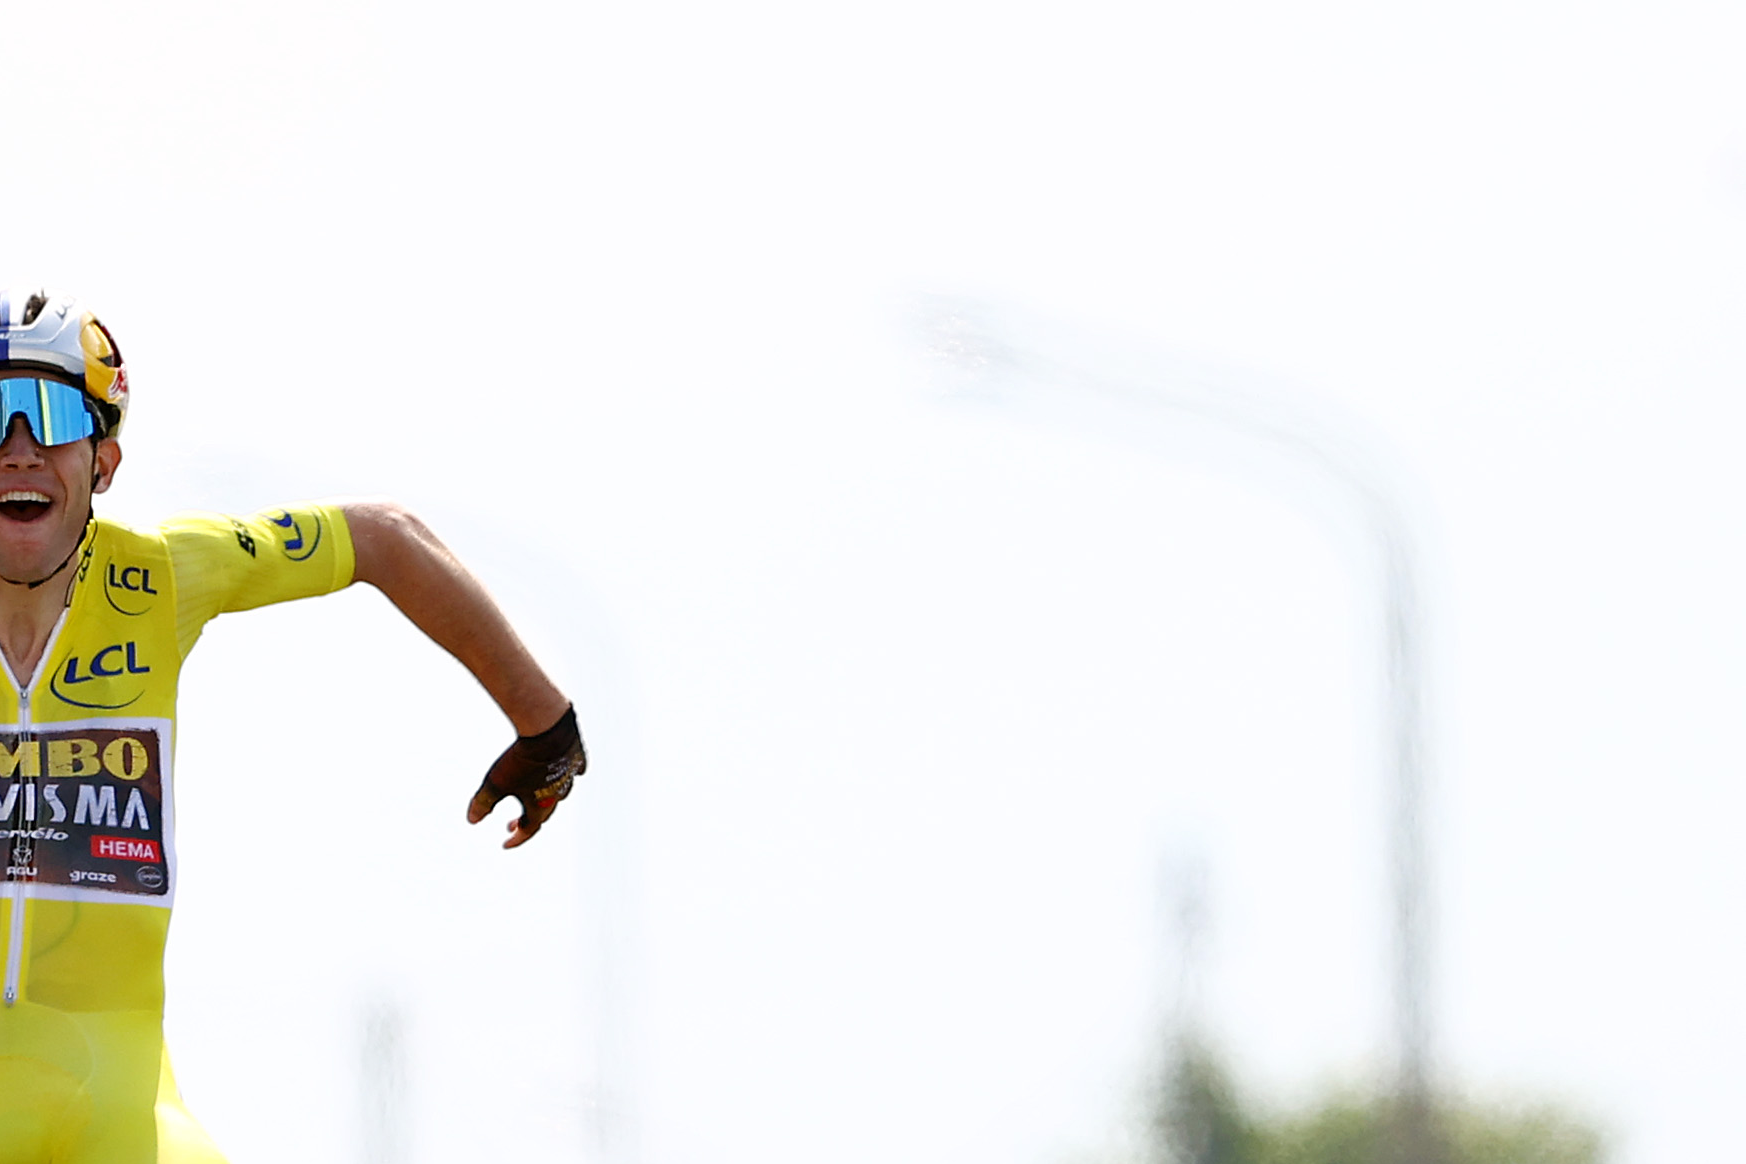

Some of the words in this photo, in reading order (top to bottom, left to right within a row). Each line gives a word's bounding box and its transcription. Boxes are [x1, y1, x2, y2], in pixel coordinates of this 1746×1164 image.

[108, 563, 158, 595] LCL
[63, 641, 150, 685] LCL
[99, 840, 155, 859] HEMA
[6, 865, 38, 876] AGU
[69, 869, 118, 884] graze
